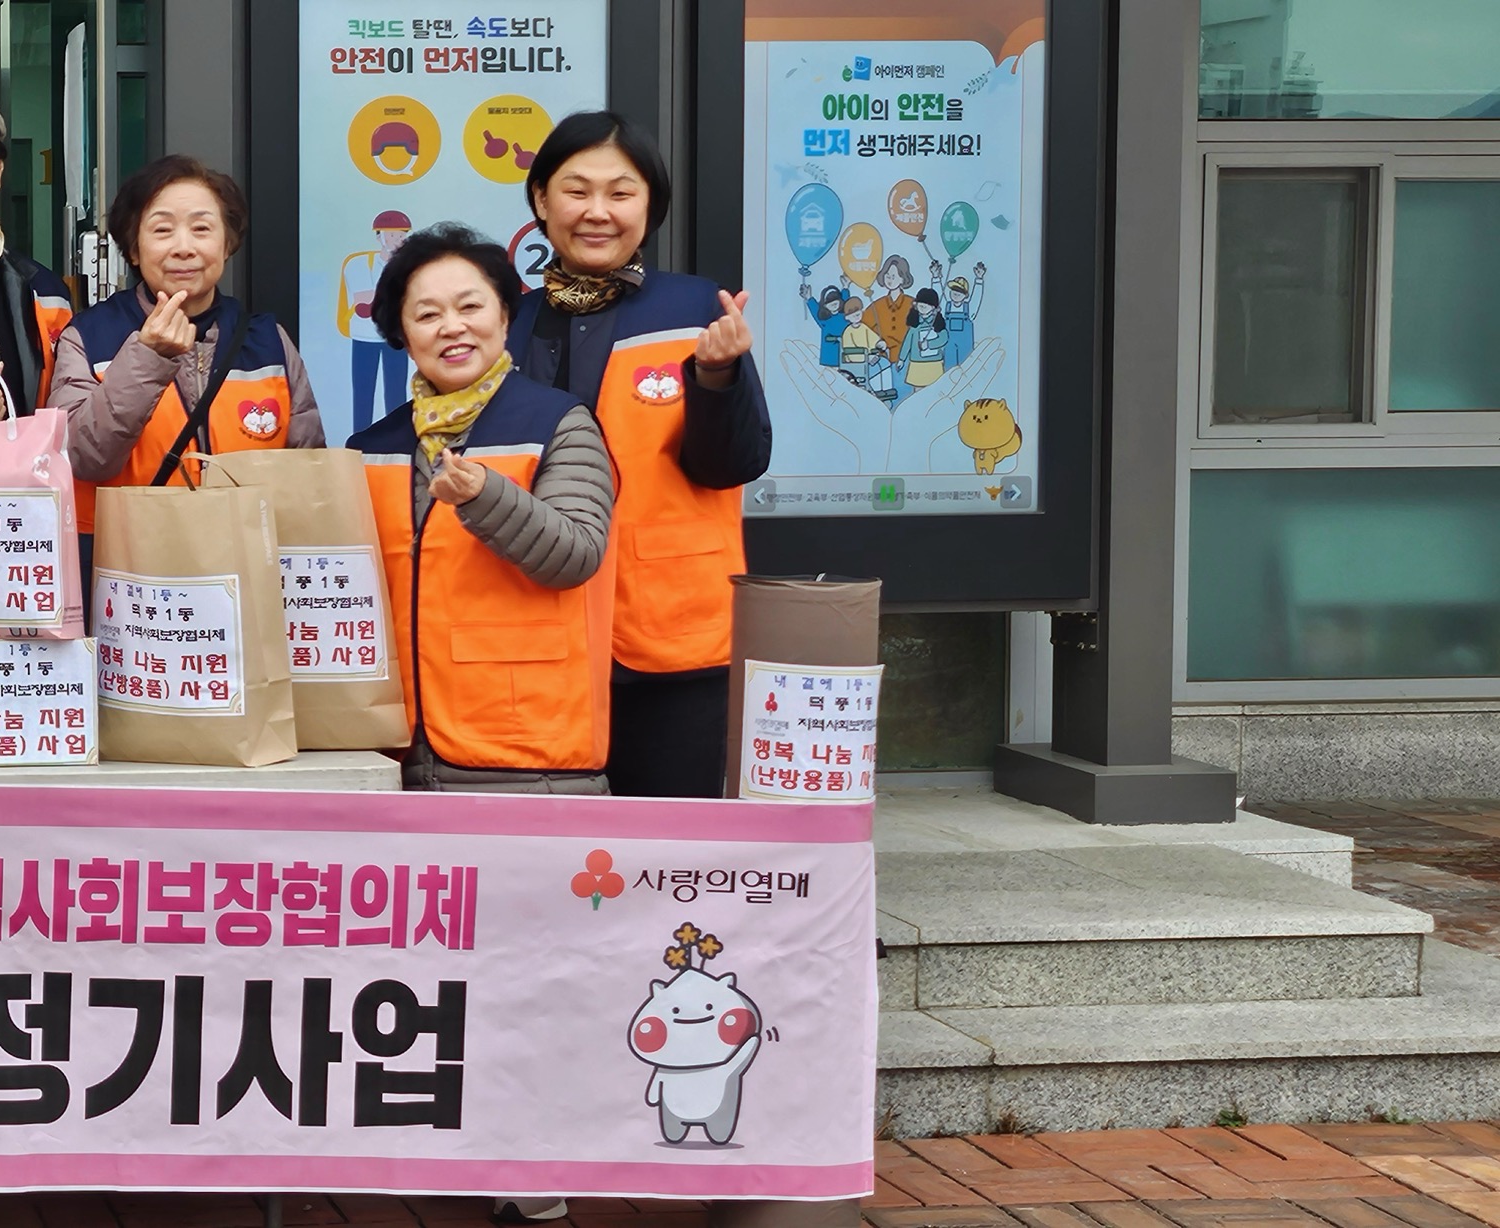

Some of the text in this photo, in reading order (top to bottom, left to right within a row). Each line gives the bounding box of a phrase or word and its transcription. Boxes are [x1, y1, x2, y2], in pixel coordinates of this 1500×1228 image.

[348, 19, 404, 38] 킥보드
[466, 16, 554, 38] 속도보다
[330, 46, 572, 74] 안전이 먼저입니다.
[874, 64, 914, 79] 아이먼저
[822, 92, 964, 121] 아이의 안전을
[804, 128, 982, 157] 먼저 생각해주세요!
[8, 565, 54, 586] 지원
[6, 592, 54, 612] 사업
[284, 596, 373, 610] 사회보장협의체
[334, 620, 374, 640] 지원
[100, 642, 228, 674] 행복 나눔 지원
[332, 646, 376, 666] 사업
[98, 668, 229, 700] (난방용품) 사업
[40, 708, 84, 728] 지원
[38, 734, 86, 755] 사업
[753, 738, 794, 762] 행복
[812, 744, 852, 765] 나눔
[751, 764, 852, 791] (난방용품)
[632, 869, 810, 904] 사랑의열매
